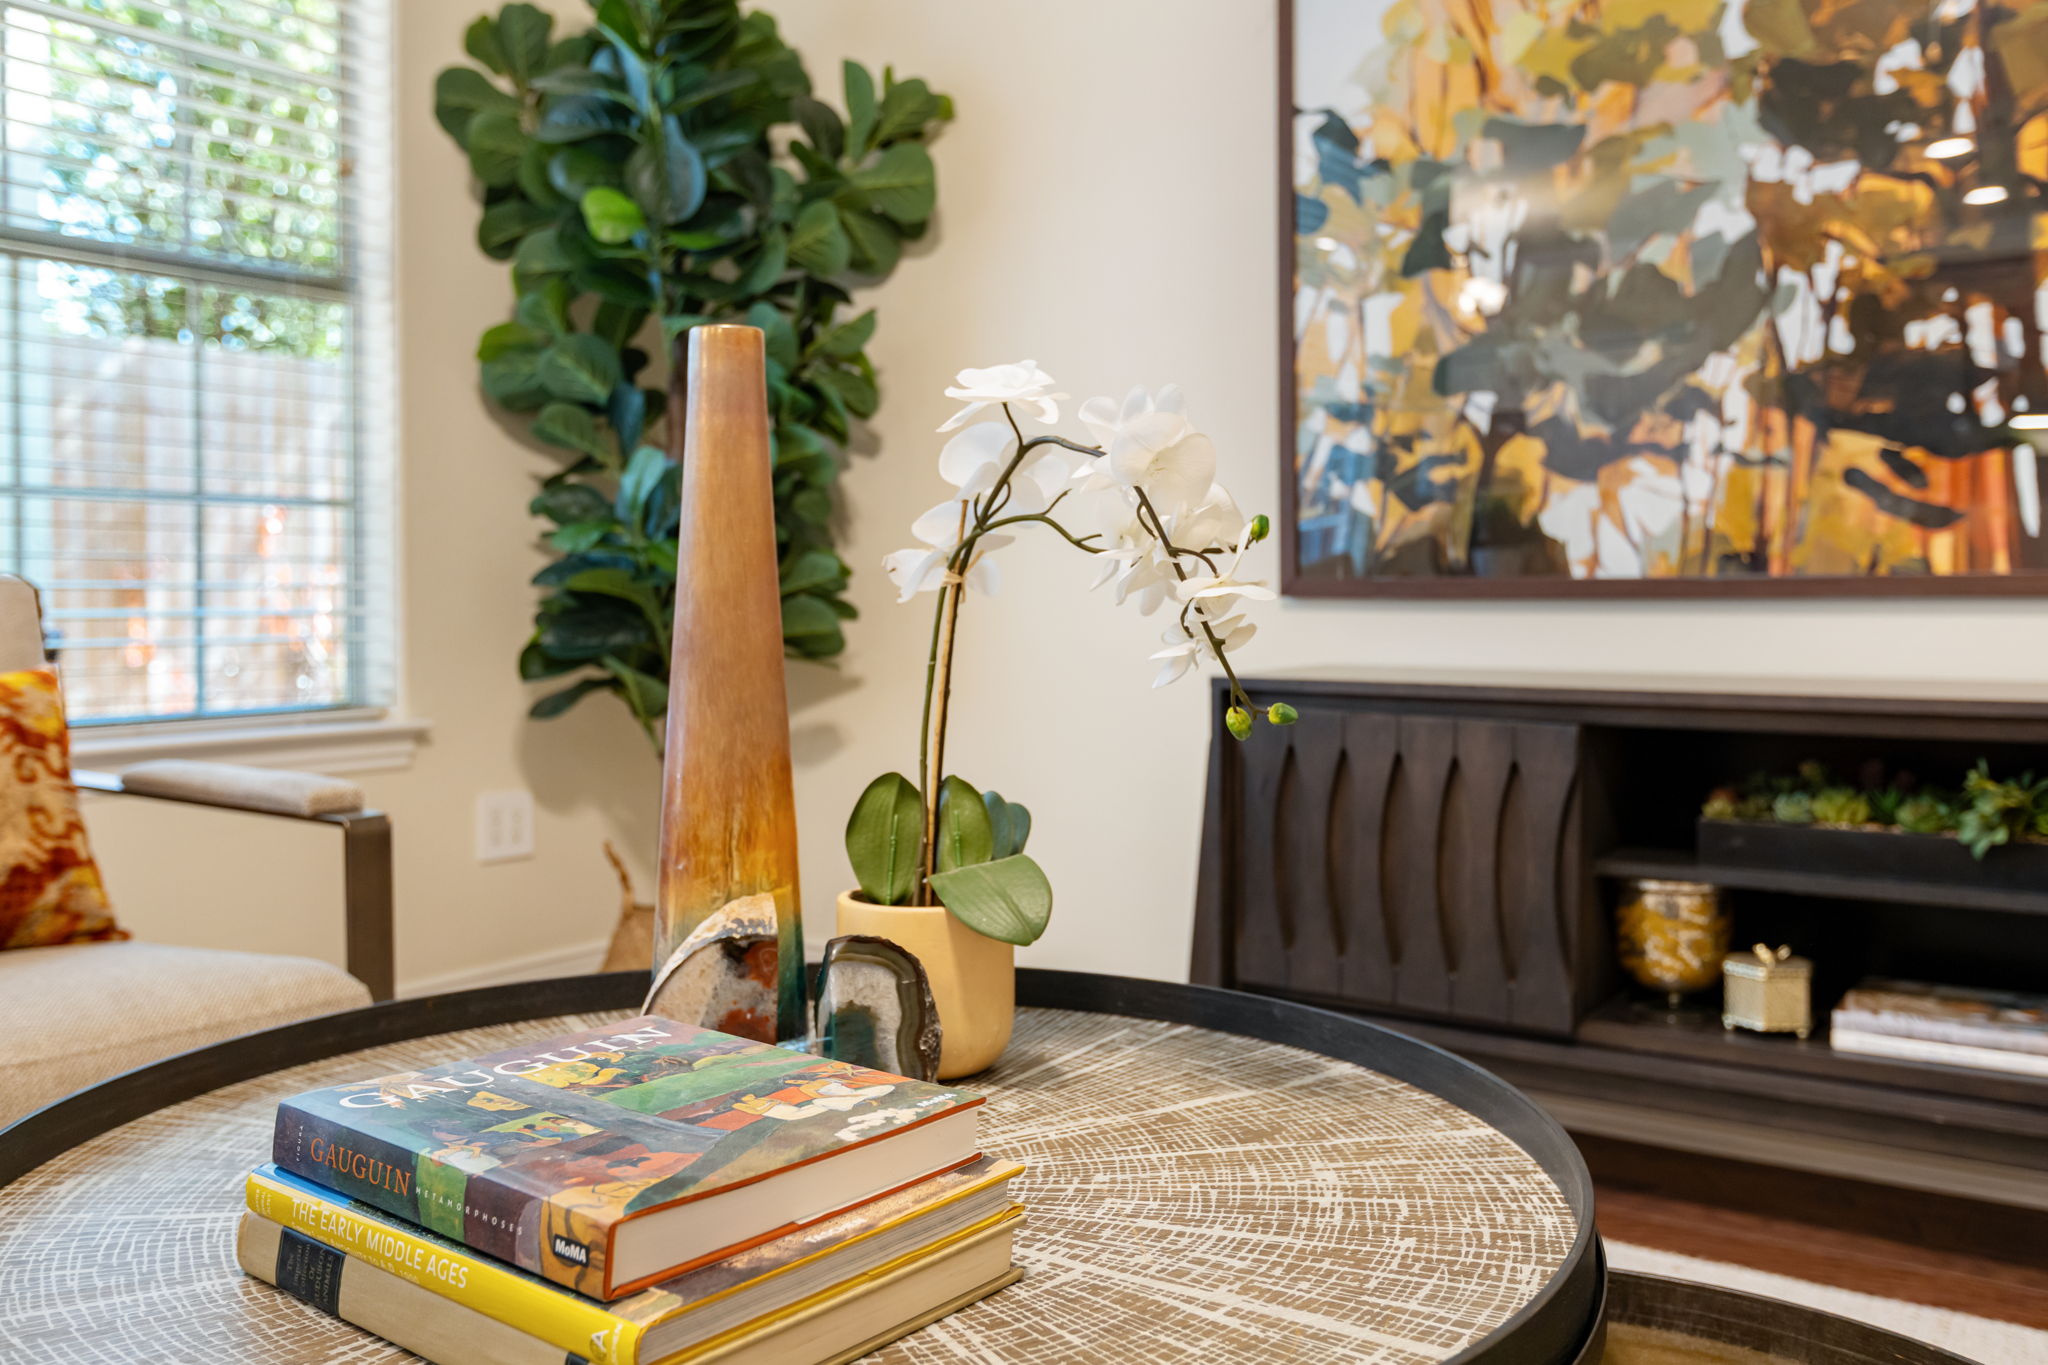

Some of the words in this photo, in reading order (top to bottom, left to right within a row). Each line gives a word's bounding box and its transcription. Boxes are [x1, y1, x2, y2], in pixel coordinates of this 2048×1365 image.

[339, 1026, 672, 1108] GAUGUIN
[310, 1137, 412, 1197] GAUGUIN
[415, 1186, 523, 1236] METAMORPHOSES
[292, 1198, 318, 1226] THE
[320, 1208, 364, 1244] EARLY
[366, 1228, 425, 1270] MIDDLE
[426, 1254, 469, 1289] AGES
[555, 1238, 587, 1264] MoMA
